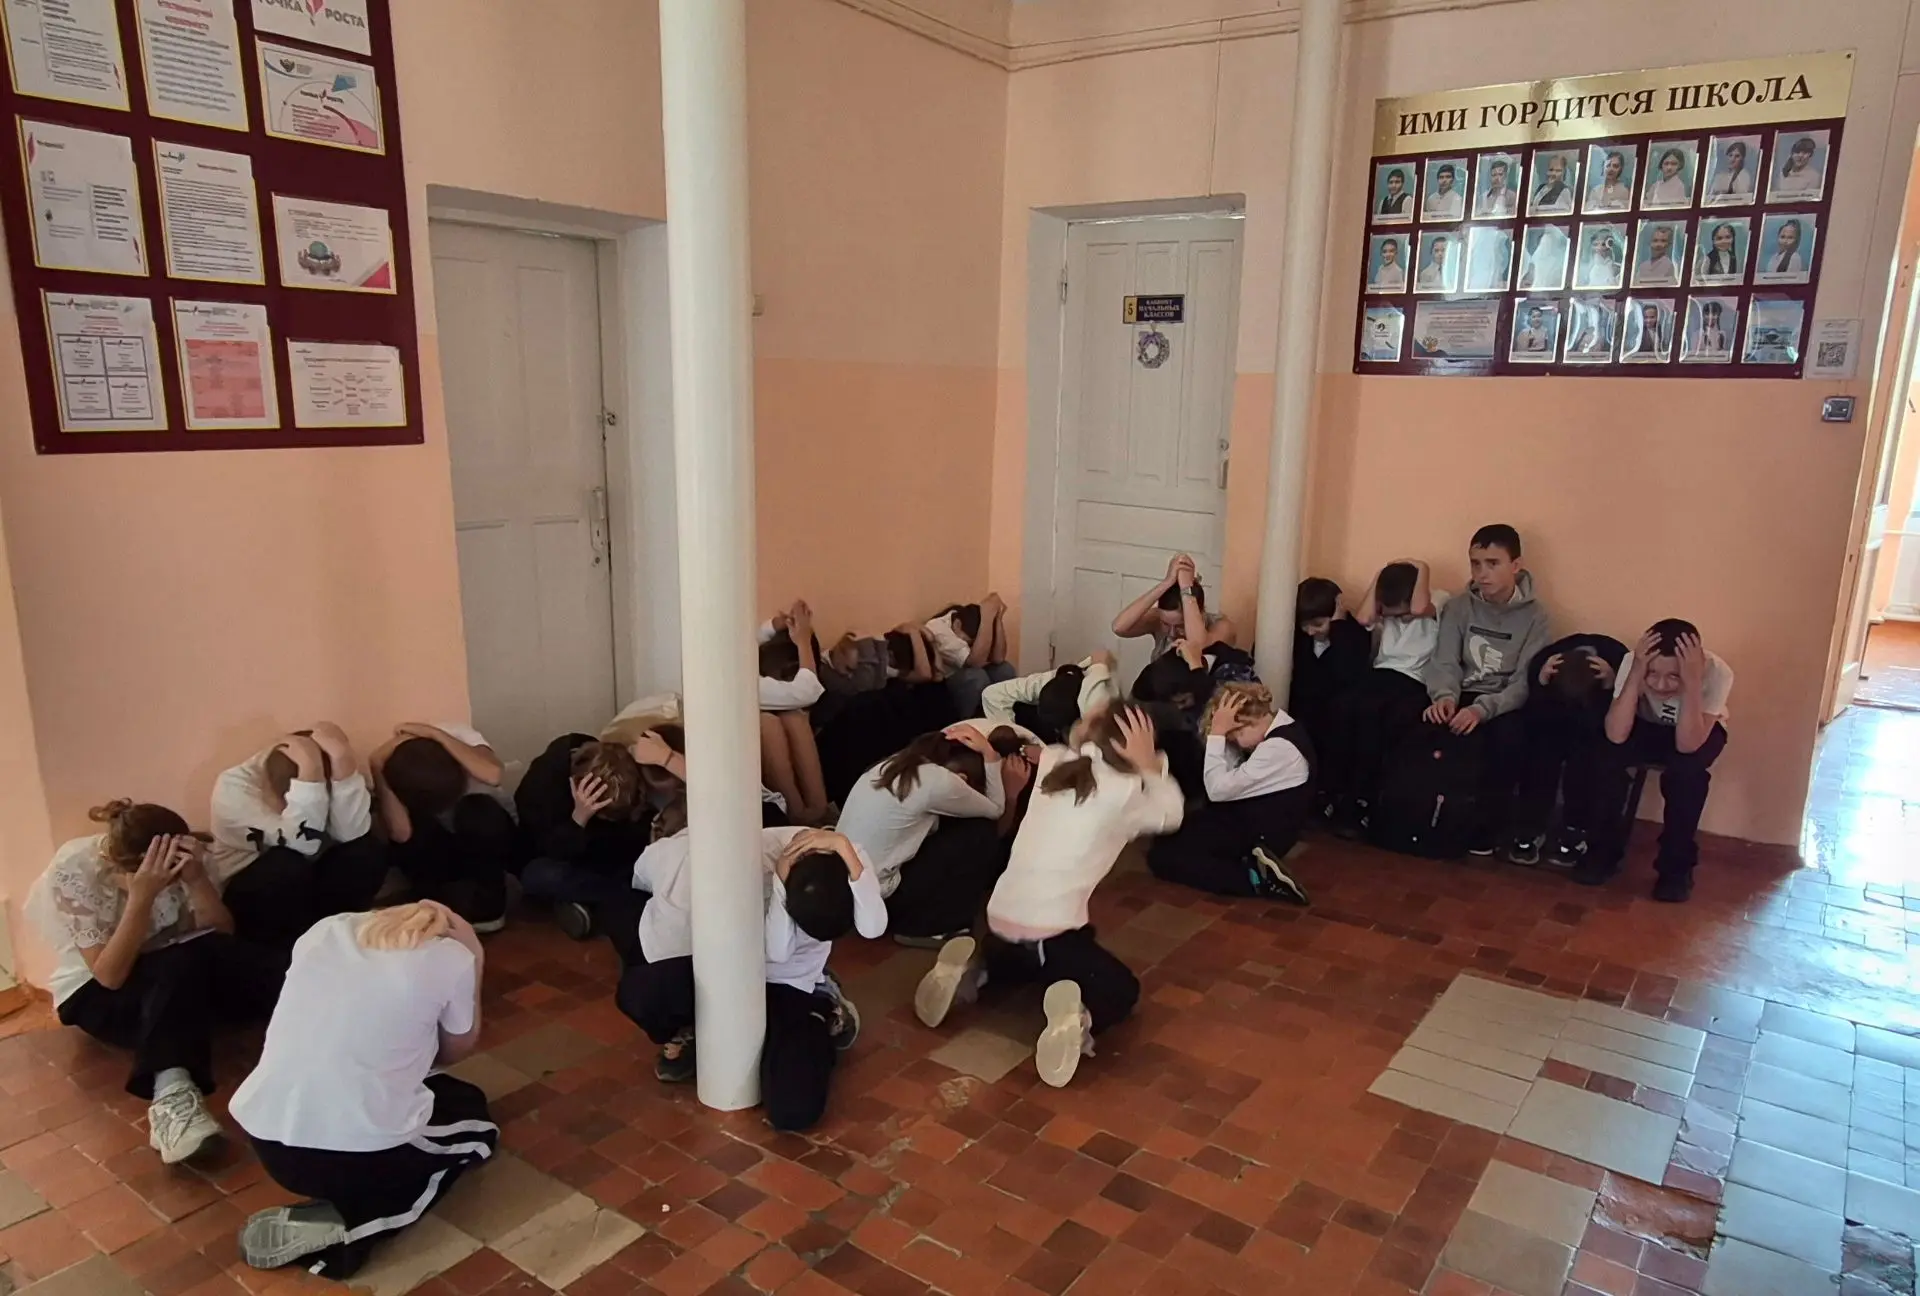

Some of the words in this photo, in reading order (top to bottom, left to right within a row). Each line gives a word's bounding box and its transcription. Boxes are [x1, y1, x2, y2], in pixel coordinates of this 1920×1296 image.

[259, 0, 303, 13] ЧКА
[325, 8, 365, 28] РОСТА
[1398, 108, 1468, 136] ИМИ
[1480, 89, 1656, 128] ГОРДИТСЯ
[1665, 74, 1812, 111] ШКОЛА
[1128, 303, 1134, 315] 5
